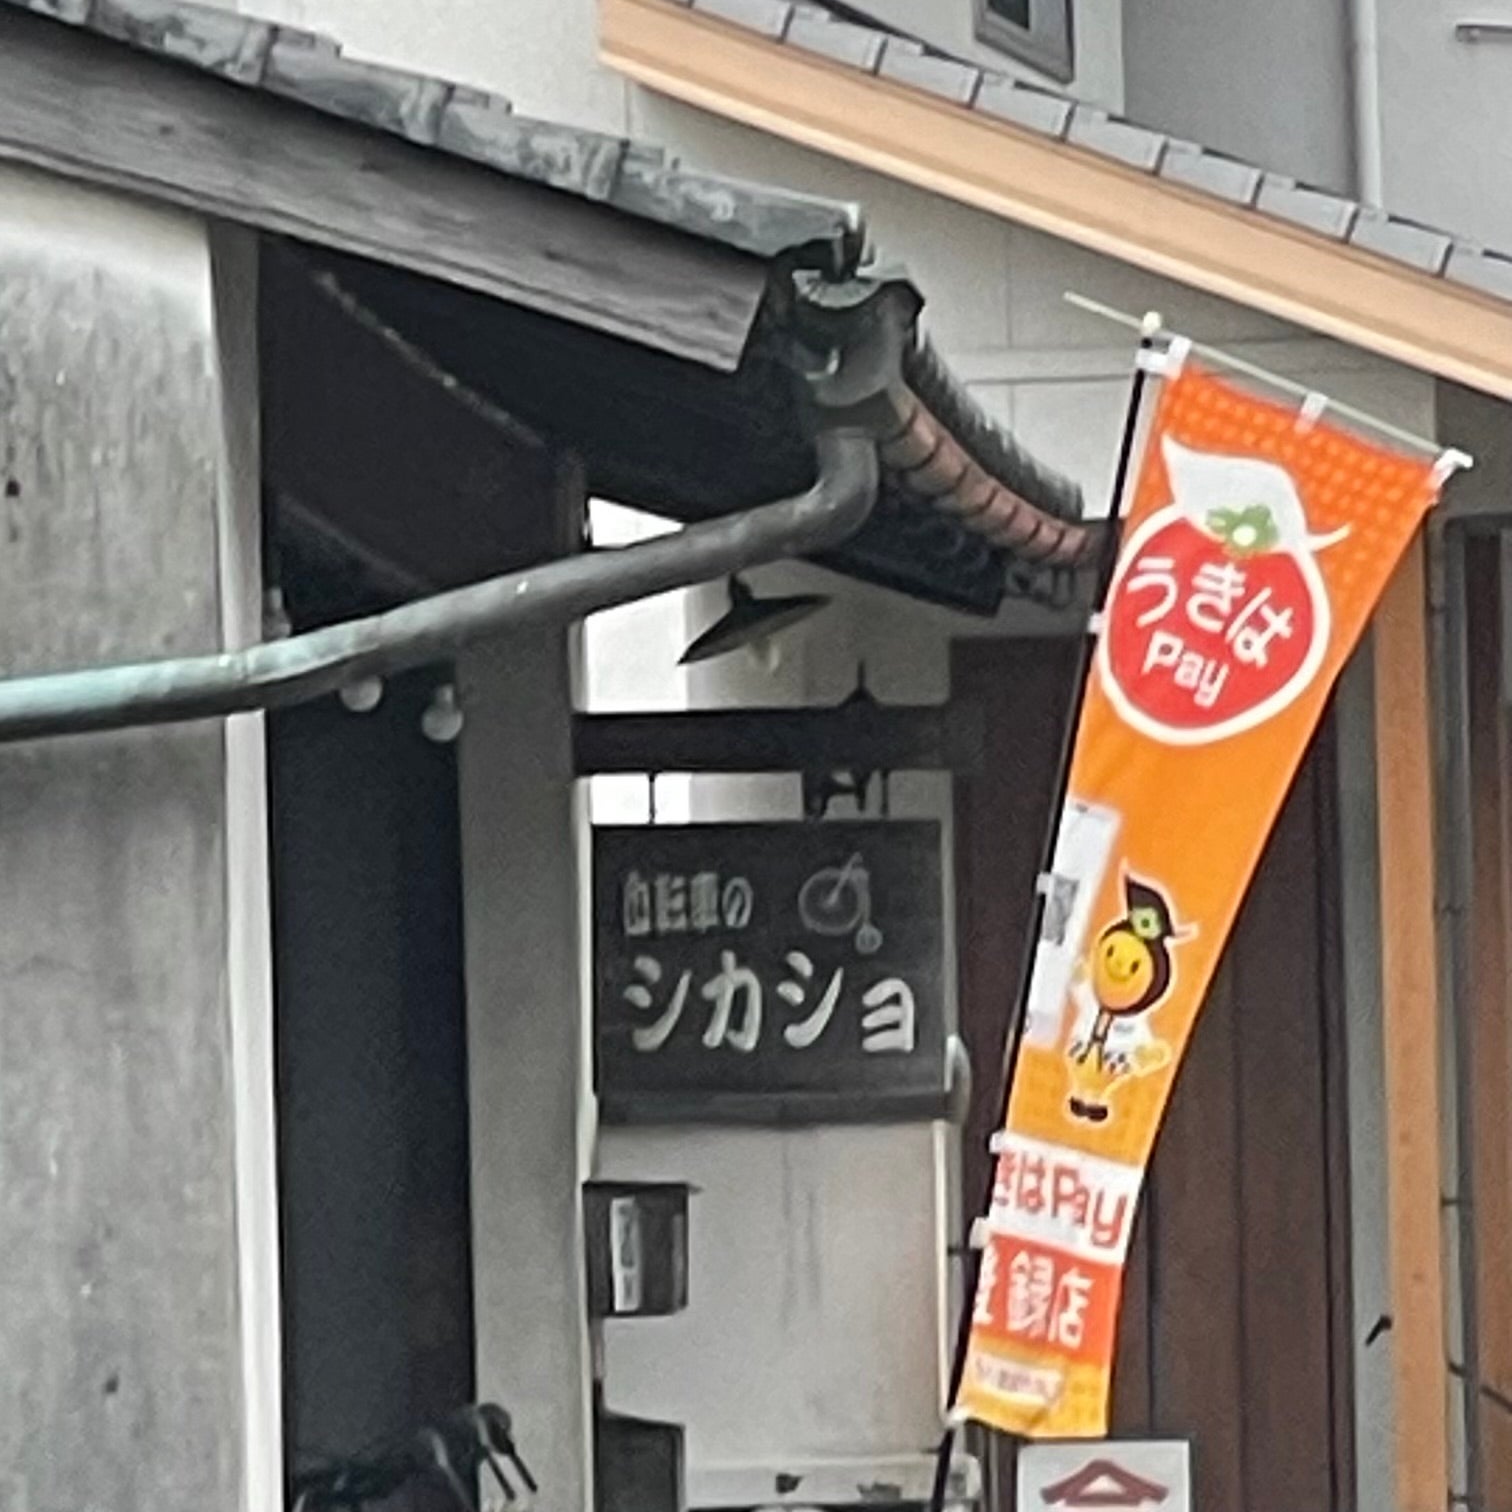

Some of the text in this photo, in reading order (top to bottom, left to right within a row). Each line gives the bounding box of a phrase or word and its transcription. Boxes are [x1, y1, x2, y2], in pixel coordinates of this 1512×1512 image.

[1126, 556, 1295, 669] うきは
[1143, 631, 1229, 708] Pay
[623, 949, 916, 1053] シカショ
